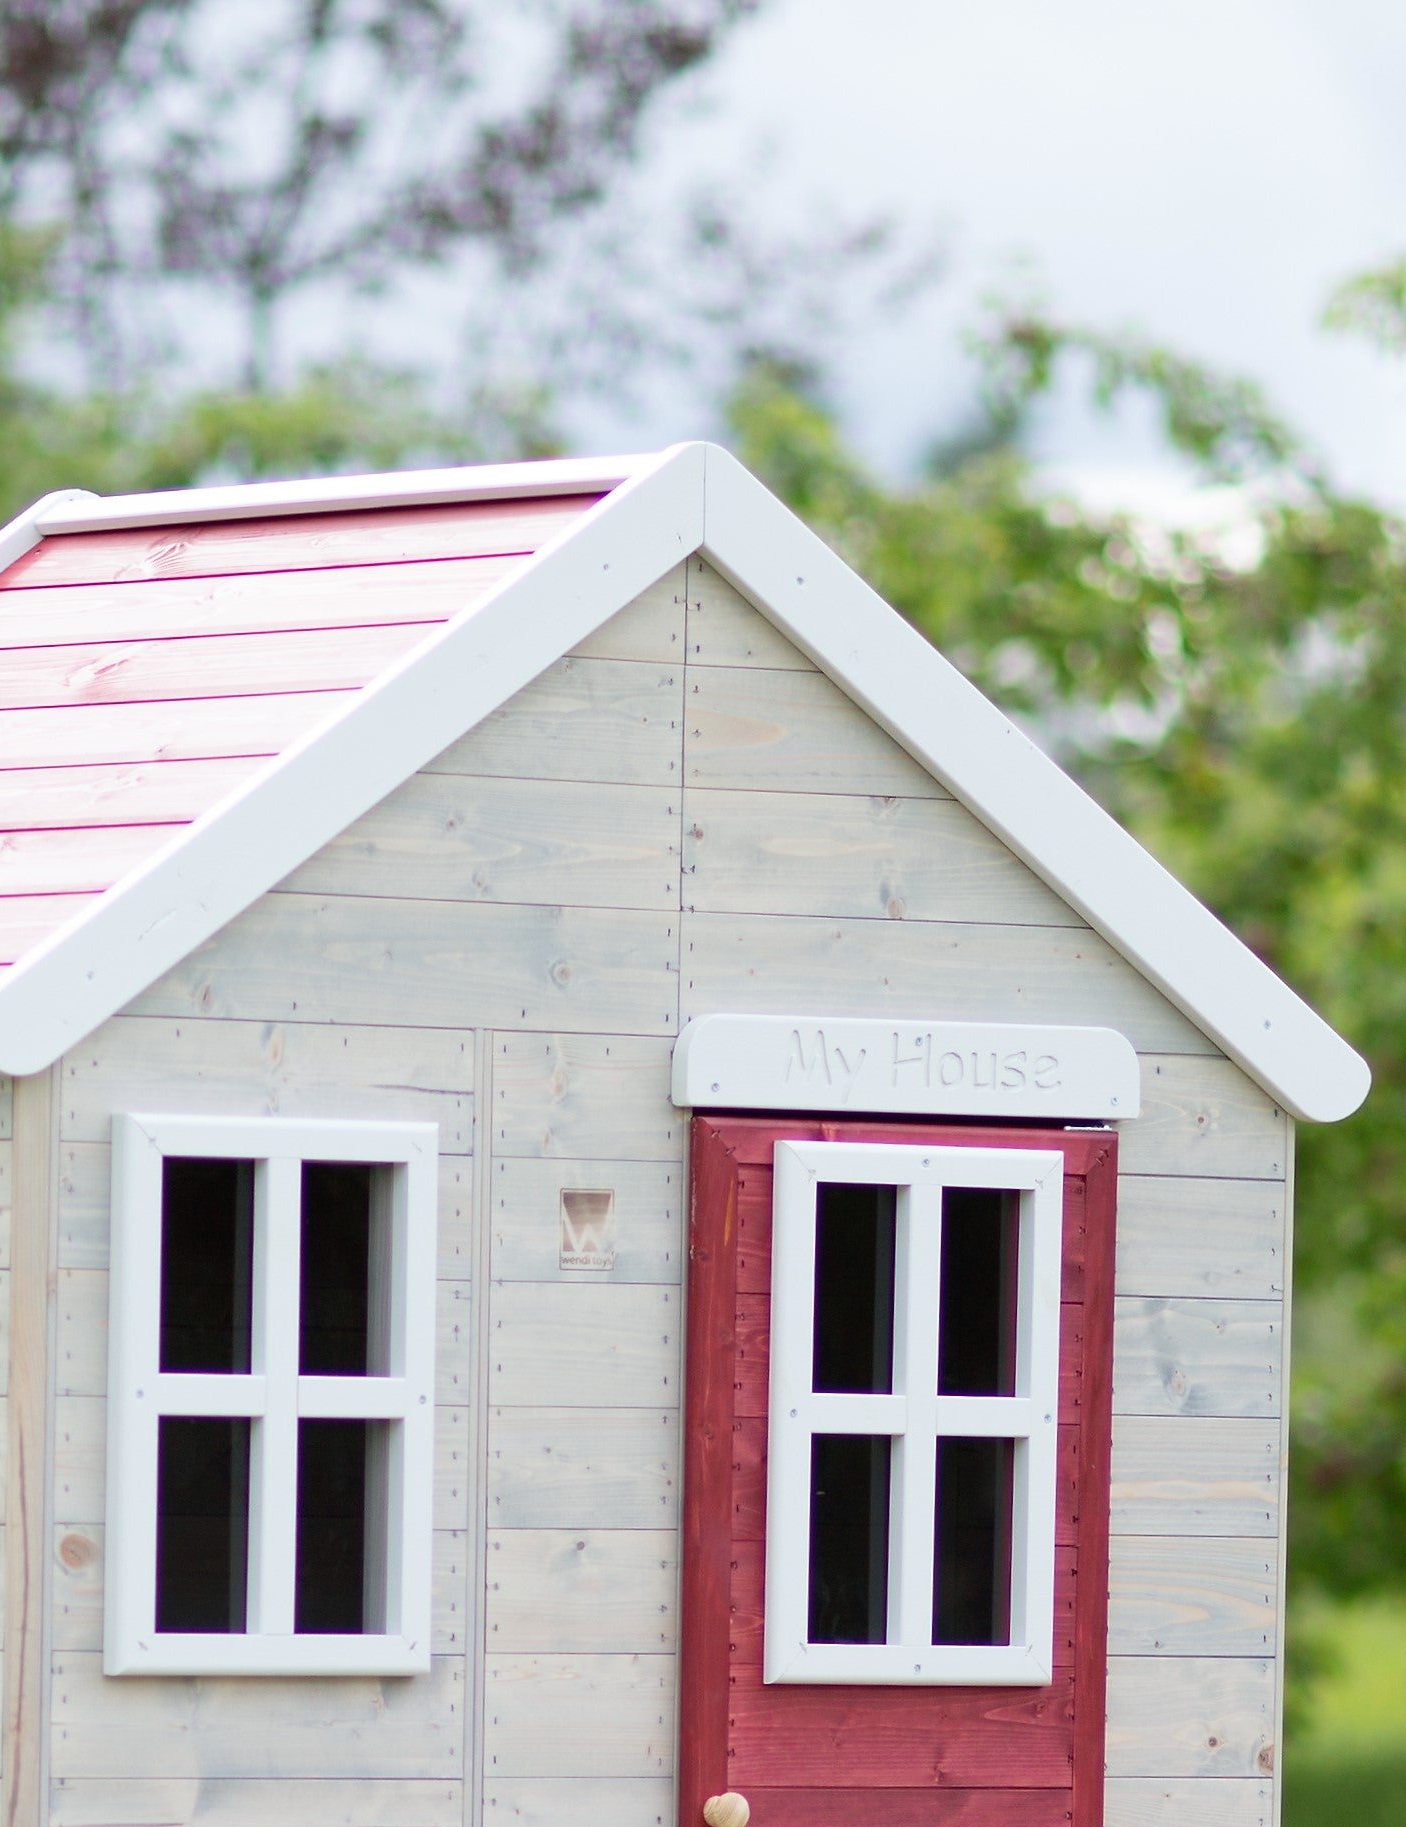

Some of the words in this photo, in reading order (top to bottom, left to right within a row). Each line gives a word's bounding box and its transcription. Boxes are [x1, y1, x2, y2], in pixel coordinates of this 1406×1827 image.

[783, 1029, 867, 1105] My
[891, 1031, 1062, 1091] House
[561, 1255, 591, 1265] wendi
